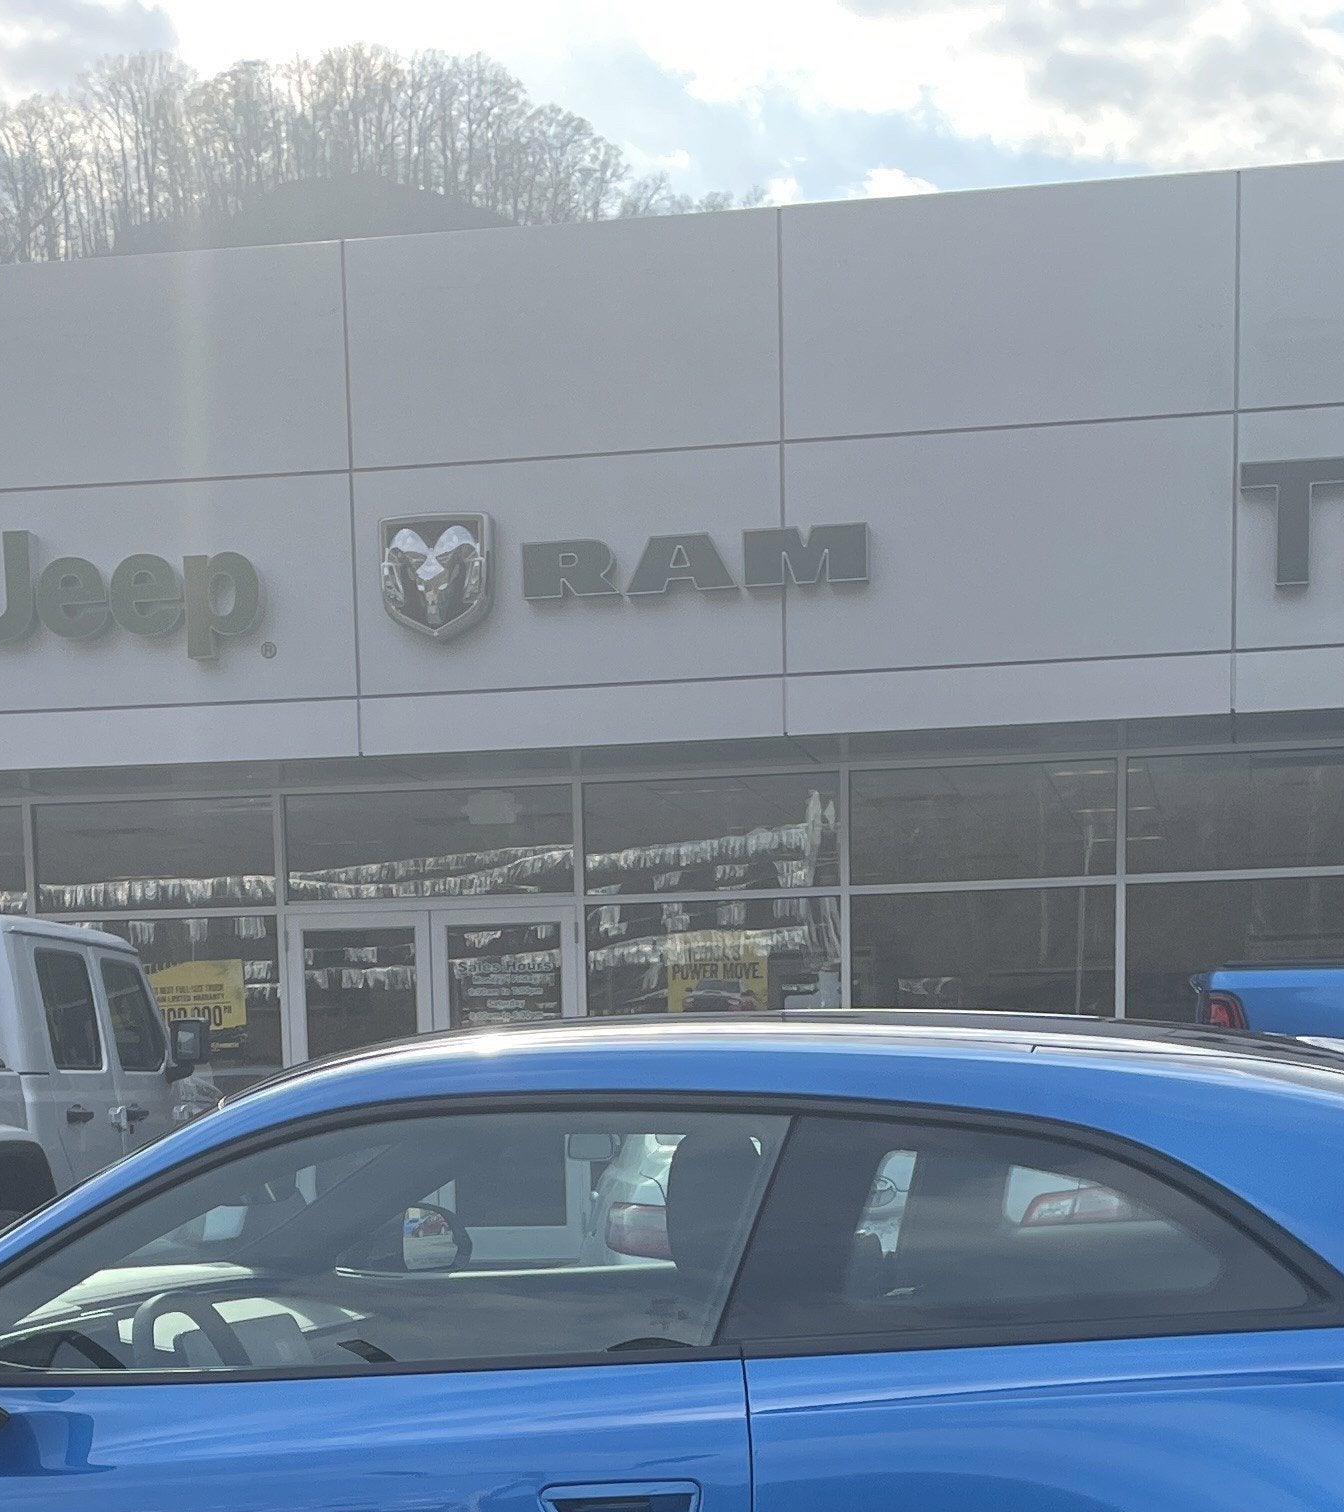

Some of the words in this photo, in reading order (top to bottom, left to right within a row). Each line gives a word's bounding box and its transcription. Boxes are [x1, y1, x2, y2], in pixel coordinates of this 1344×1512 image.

[522, 522, 869, 600] RAM
[458, 961, 502, 973] Sales
[506, 961, 554, 972] Hours
[672, 963, 718, 980] POWER
